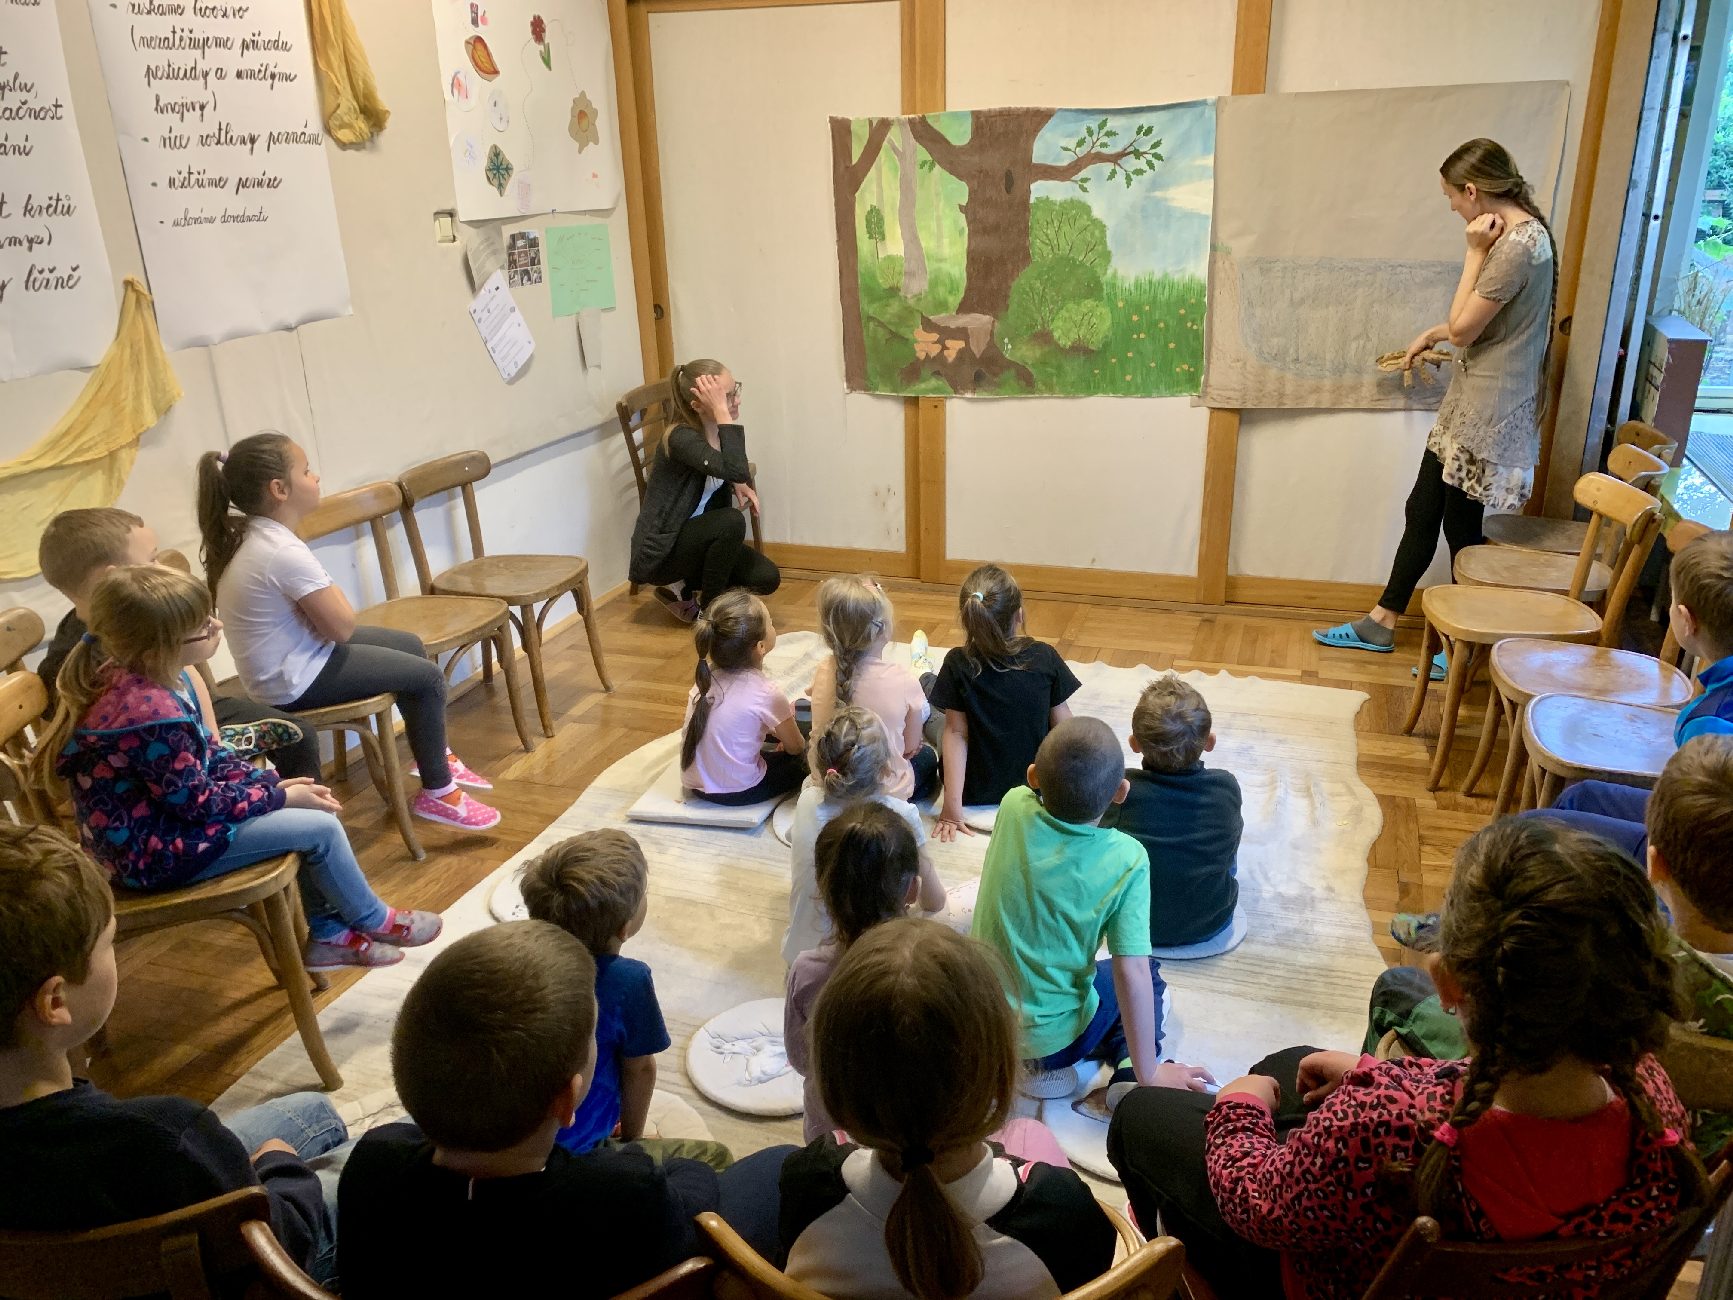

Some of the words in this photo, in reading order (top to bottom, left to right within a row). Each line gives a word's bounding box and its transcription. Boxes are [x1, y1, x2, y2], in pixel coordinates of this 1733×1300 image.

[145, 58, 212, 90] pesticidy
[215, 67, 228, 81] a
[199, 121, 260, 154] rostliny
[235, 170, 282, 195] peníze
[23, 192, 77, 218] květů
